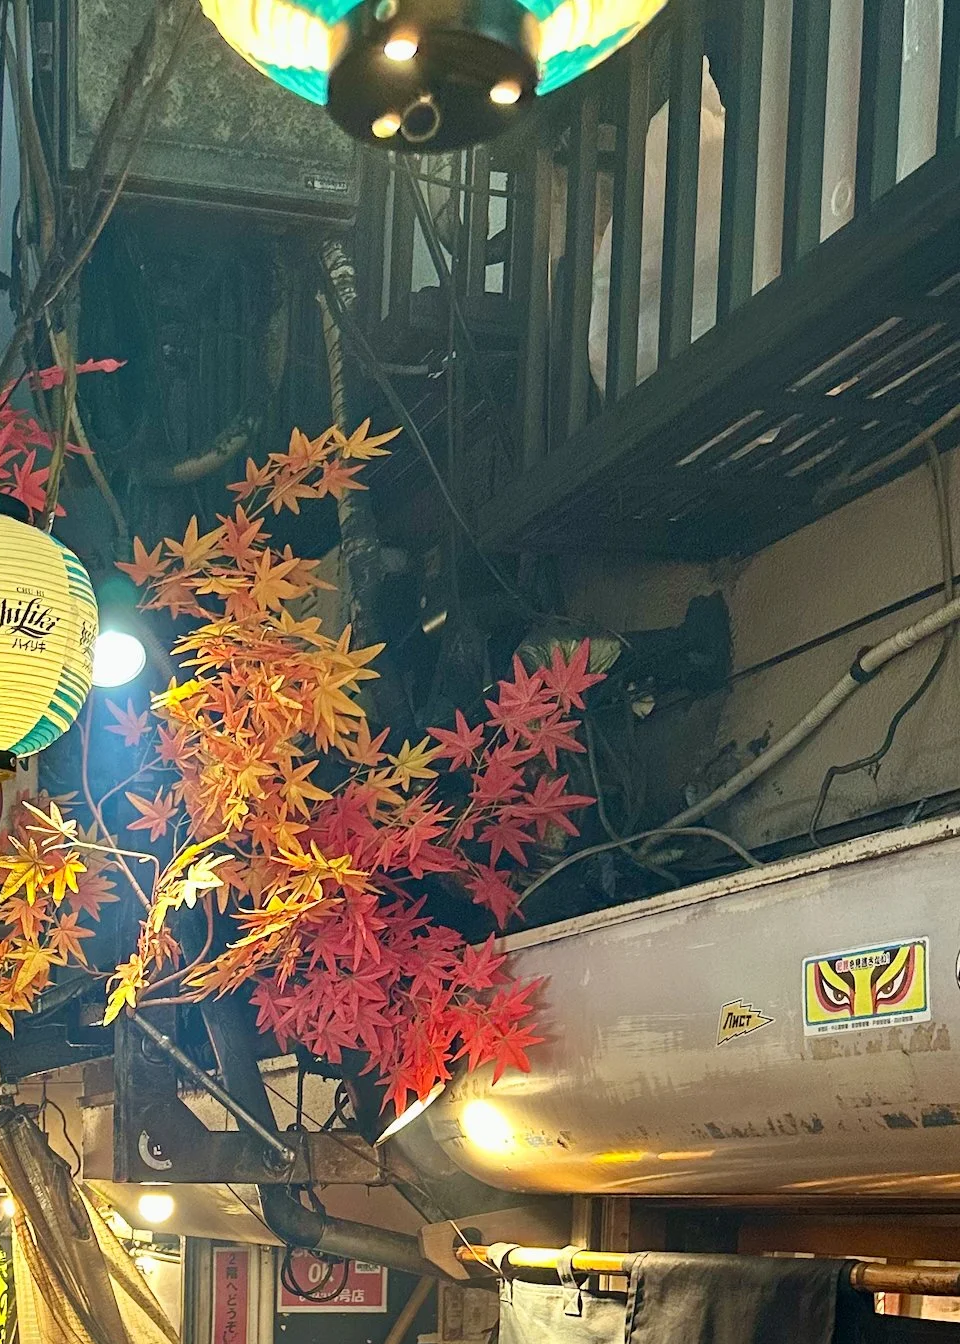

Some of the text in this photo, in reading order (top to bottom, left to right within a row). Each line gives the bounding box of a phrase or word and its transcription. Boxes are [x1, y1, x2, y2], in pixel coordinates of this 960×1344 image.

[12, 639, 46, 653] ハイリキ
[225, 1254, 238, 1334] 2階へどうぞ
